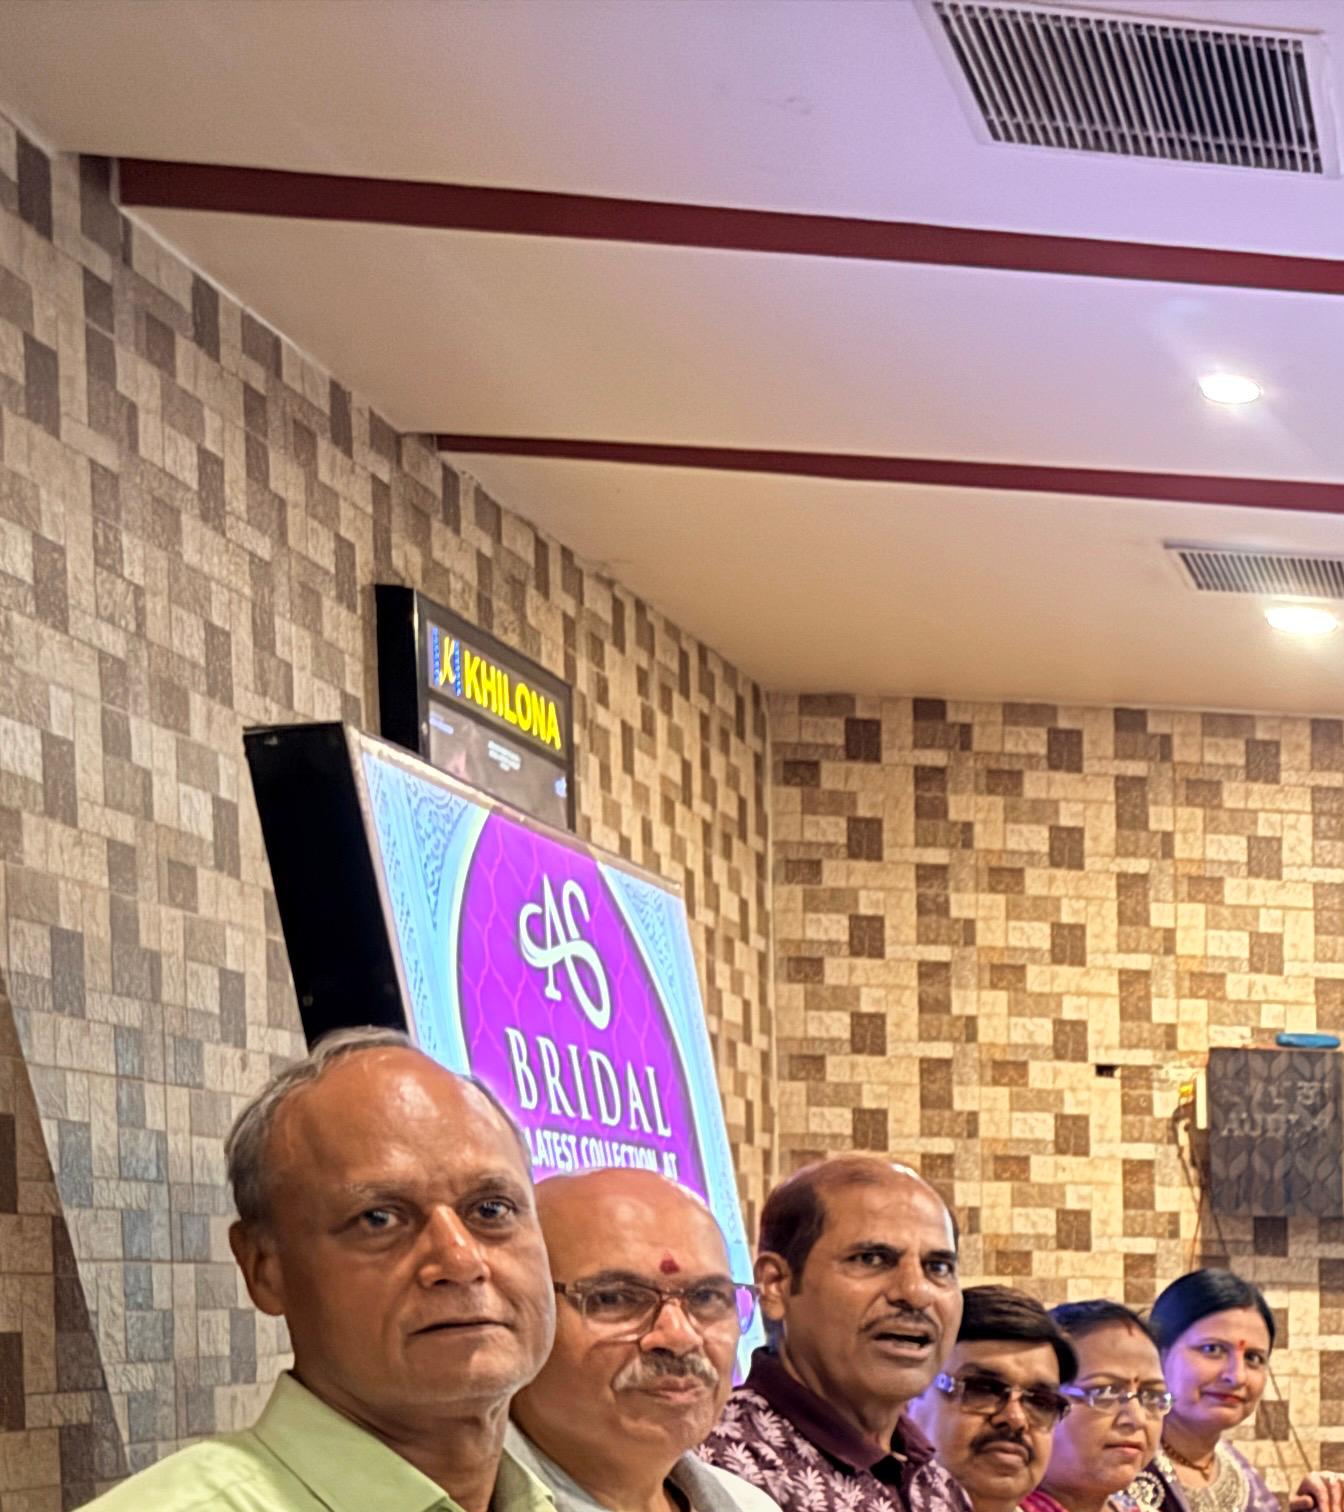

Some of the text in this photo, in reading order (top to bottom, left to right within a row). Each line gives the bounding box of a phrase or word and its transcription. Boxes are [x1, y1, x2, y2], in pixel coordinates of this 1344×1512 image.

[464, 650, 561, 750] KHILONA
[504, 1026, 672, 1137] BRIDAL
[525, 1127, 580, 1172] LATEST
[581, 1136, 658, 1172] COLLECTION
